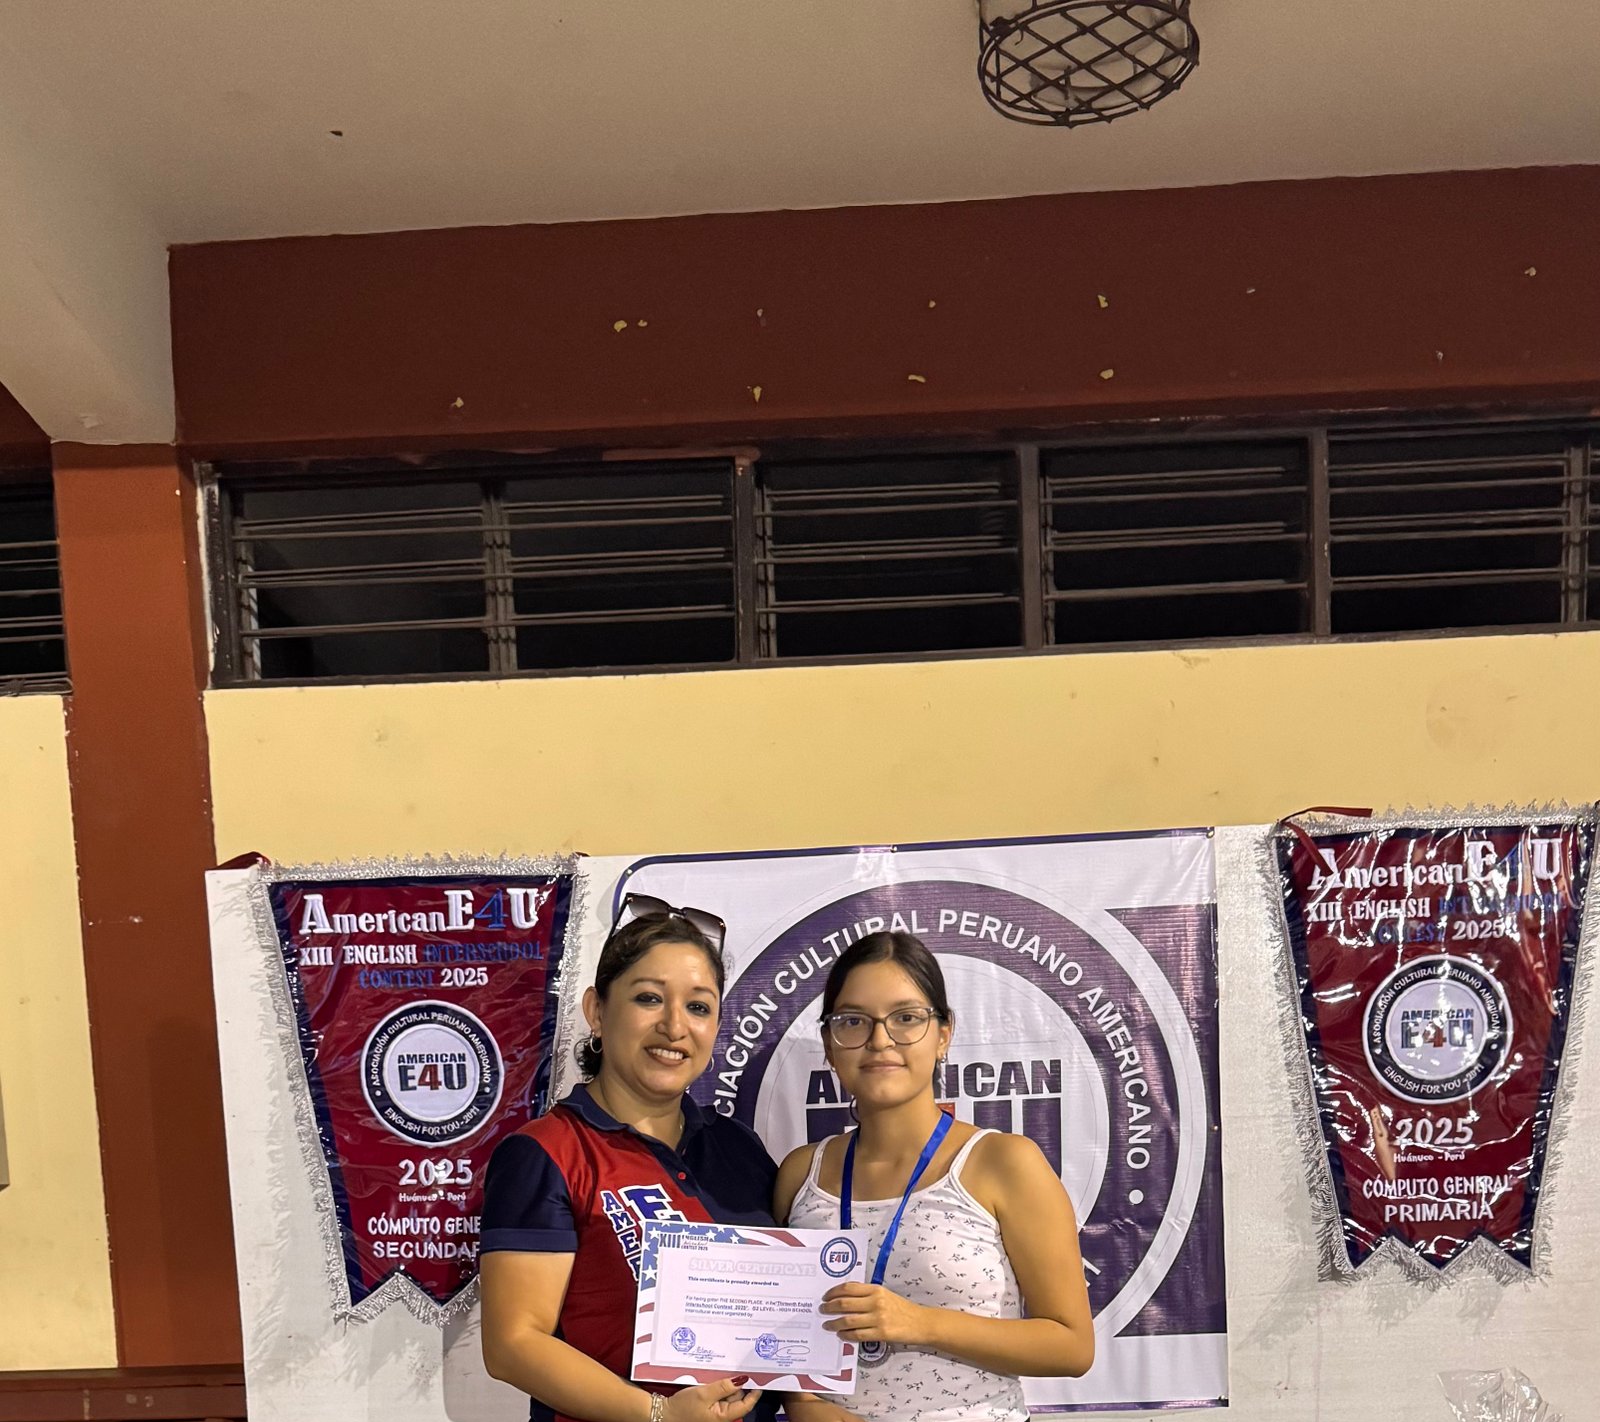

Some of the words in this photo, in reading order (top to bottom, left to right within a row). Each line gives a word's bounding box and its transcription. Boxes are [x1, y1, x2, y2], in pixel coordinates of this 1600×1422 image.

[1307, 901, 1342, 922] XIII
[1352, 897, 1431, 920] ENGLISH
[1452, 919, 1504, 941] 2025
[299, 946, 334, 966] XIII
[342, 944, 418, 965] ENGLISH
[359, 969, 435, 989] CONTEST
[440, 966, 489, 987] 2025
[1393, 967, 1439, 990] CULTURAL
[1441, 967, 1482, 989] ERUANO
[1401, 1008, 1474, 1021] AMERCAN
[713, 993, 779, 1119] CIACIÓN
[938, 908, 1083, 987] PERUANO
[1077, 986, 1152, 1171] AMERICANO
[1400, 1018, 1474, 1049] E4U
[371, 1032, 390, 1086] ASOCIACIÓN
[388, 1011, 430, 1035] CULTURAL
[431, 1011, 472, 1035] PERUANO
[468, 1032, 491, 1084] AMERICANO
[397, 1052, 467, 1064] AMERICAN
[397, 1063, 468, 1092] E4U
[805, 1058, 1062, 1105] AICAN
[1383, 1066, 1420, 1092] ENGLISH
[1420, 1085, 1440, 1094] FOR
[1441, 1079, 1461, 1092] YOU
[384, 1107, 421, 1135] ENGLISH
[421, 1126, 441, 1136] FOR
[441, 1120, 460, 1135] YOU
[463, 1105, 480, 1125] 2011
[1395, 1117, 1474, 1145] 2025
[398, 1158, 474, 1187] 2025
[1362, 1173, 1439, 1199] CÓMPUTO
[1443, 1174, 1513, 1196] GENERAL
[367, 1211, 441, 1236] CÓMPUTO
[444, 1215, 482, 1235] GENE
[1384, 1200, 1495, 1223] PRIMARIA
[372, 1241, 481, 1259] SECUNDA
[658, 1233, 681, 1249] XIII
[688, 1257, 735, 1273] SILVER
[735, 1260, 817, 1277] CERTIFICATE
[829, 1253, 850, 1263] E4U
